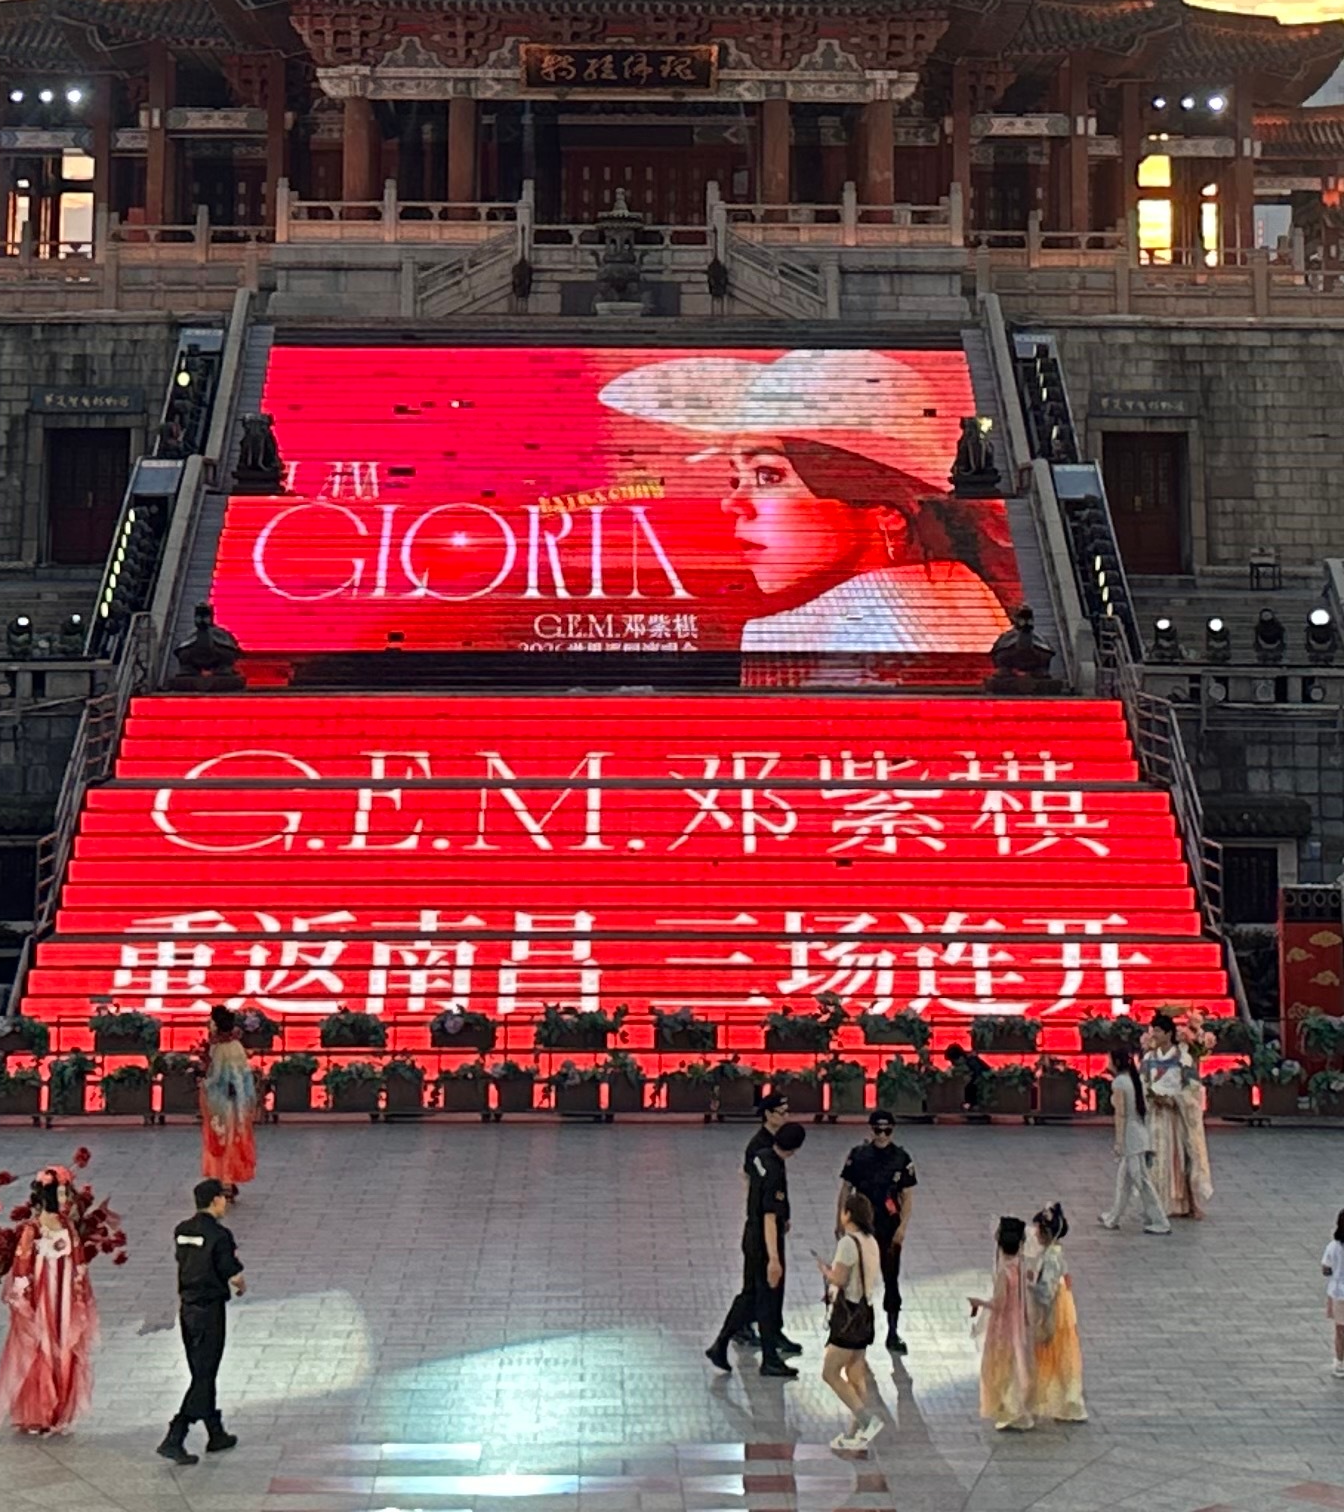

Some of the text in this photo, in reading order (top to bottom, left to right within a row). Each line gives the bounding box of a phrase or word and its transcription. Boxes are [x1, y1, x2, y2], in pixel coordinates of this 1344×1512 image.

[108, 909, 1153, 1017] 重返南昌 三场连开
